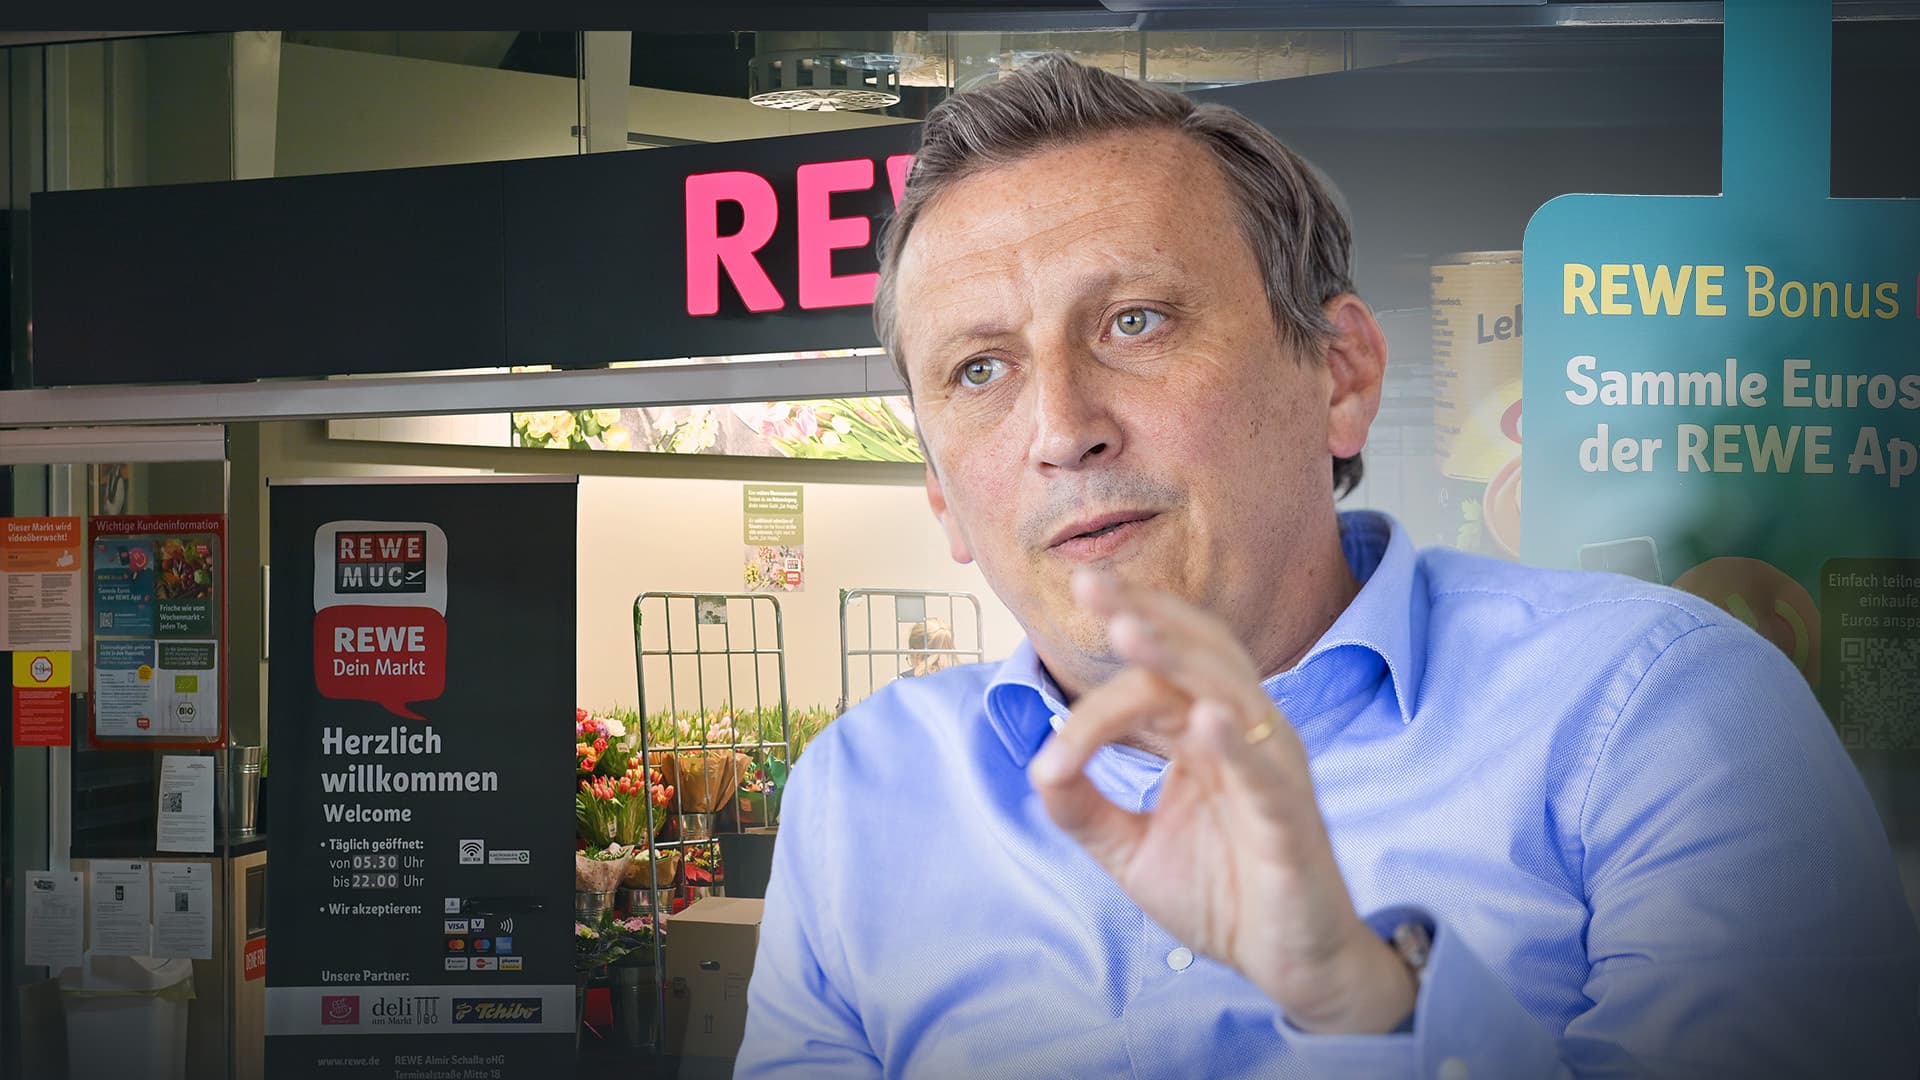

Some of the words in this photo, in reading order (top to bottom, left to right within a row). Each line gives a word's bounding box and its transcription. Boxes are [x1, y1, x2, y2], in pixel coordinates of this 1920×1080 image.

[685, 154, 915, 316] RE
[1563, 263, 1727, 316] REWE
[1744, 265, 1899, 320] Bonus
[1565, 355, 1768, 408] Sammle
[1783, 358, 1920, 409] Euros
[1578, 424, 1662, 473] der
[1677, 424, 1834, 474] REWE
[1847, 426, 1920, 488] Ap
[8, 523, 31, 532] Dieser
[32, 523, 54, 532] Markt
[55, 522, 72, 531] wird
[96, 520, 135, 532] Wichtige
[137, 519, 219, 531] Kundeninformation
[8, 533, 68, 542] videoüberwacht!
[340, 537, 421, 560] REWE
[342, 567, 403, 588] MUC
[1828, 573, 1878, 588] Einfach
[160, 604, 181, 612] Frische
[160, 613, 200, 621] Wochenmarkt
[1841, 613, 1879, 627] Euros
[160, 623, 176, 631] jeden
[334, 626, 426, 653] REWE
[333, 658, 370, 676] Dein
[374, 658, 426, 676] Markt
[321, 726, 441, 755] Herzlich
[320, 764, 498, 793] willkommen
[323, 803, 412, 823] Welcome
[329, 838, 370, 853] Täglich
[371, 837, 424, 853] geöffnet:
[329, 860, 350, 869] von
[353, 856, 397, 869] 05.30
[403, 855, 424, 868] Uhr
[333, 875, 350, 888] bis
[352, 874, 396, 887] 22.00
[403, 874, 424, 888] Uhr
[328, 903, 350, 915] Wir
[351, 902, 422, 917] akzeptieren:
[321, 969, 361, 982] Unsere
[363, 969, 410, 982] Partner:
[372, 997, 411, 1016] deli
[475, 1002, 540, 1020] Tchibo
[388, 1016, 412, 1025] Markt
[317, 1056, 381, 1067] www.rewe.de
[395, 1055, 423, 1065] REWE
[425, 1055, 450, 1065] Almir
[463, 1069, 488, 1080] Mitte
